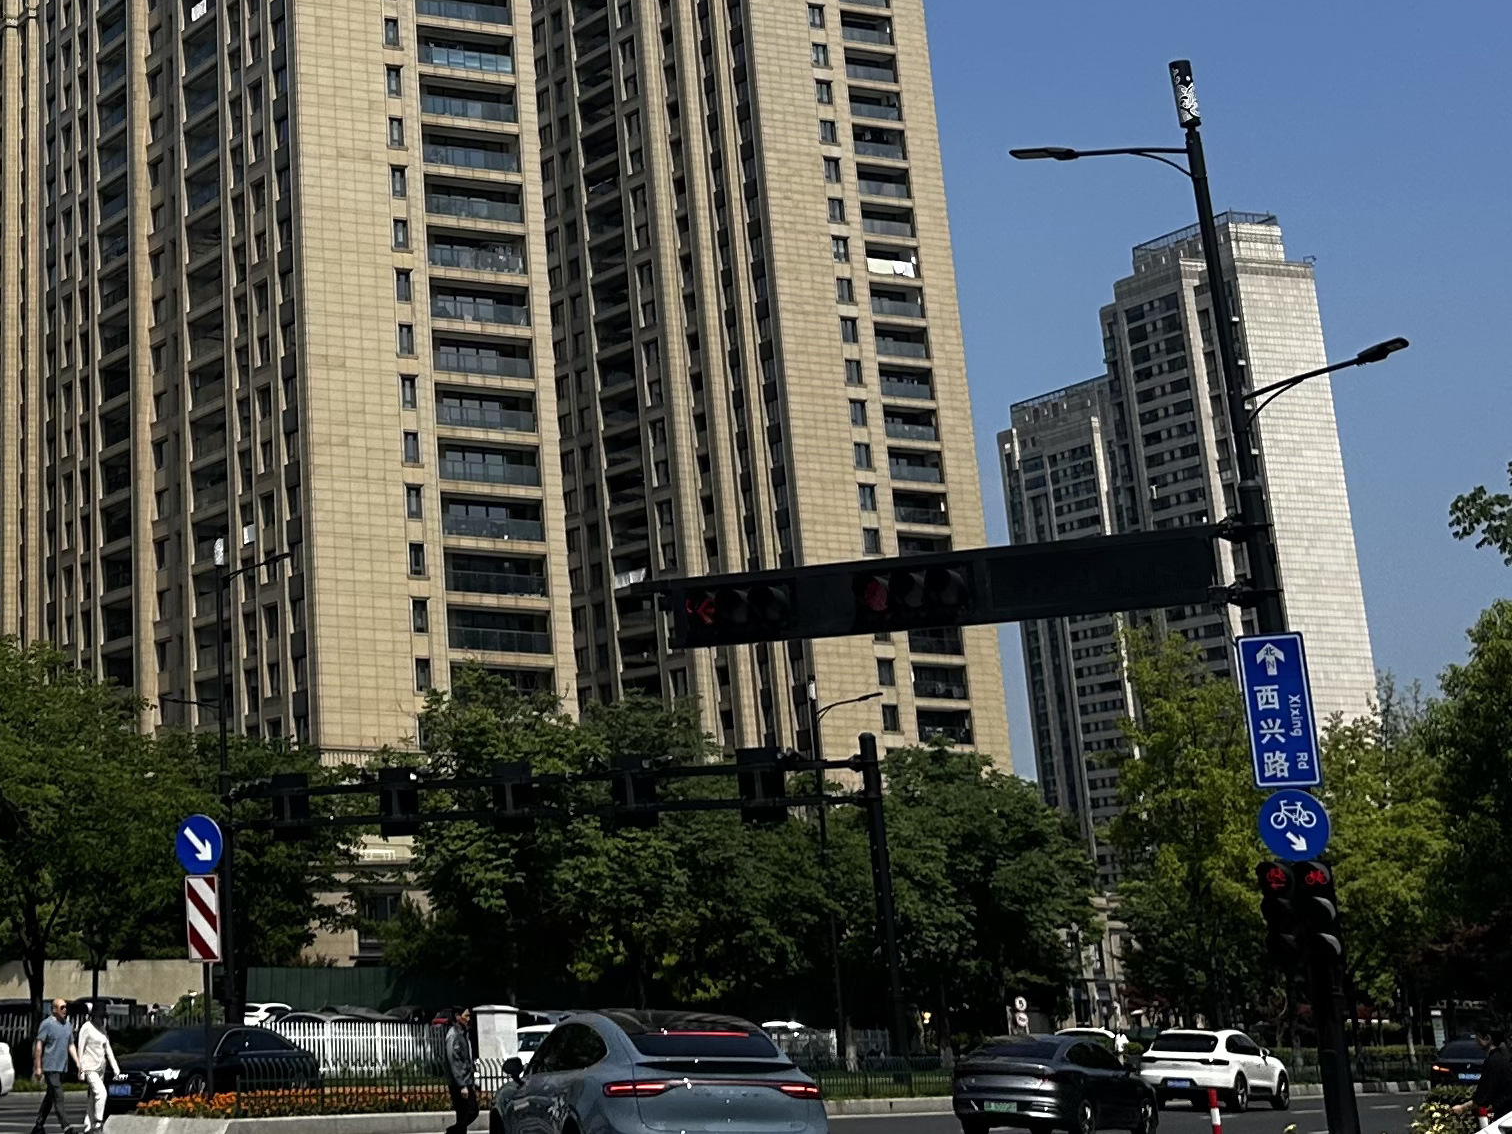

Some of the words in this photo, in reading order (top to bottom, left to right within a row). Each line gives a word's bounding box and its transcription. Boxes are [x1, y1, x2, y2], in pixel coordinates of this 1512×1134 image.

[1264, 646, 1275, 656] 北
[1267, 660, 1276, 669] N
[1253, 684, 1290, 779] 西兴路
[1288, 693, 1303, 737] Xixing
[1296, 752, 1309, 770] Rd
